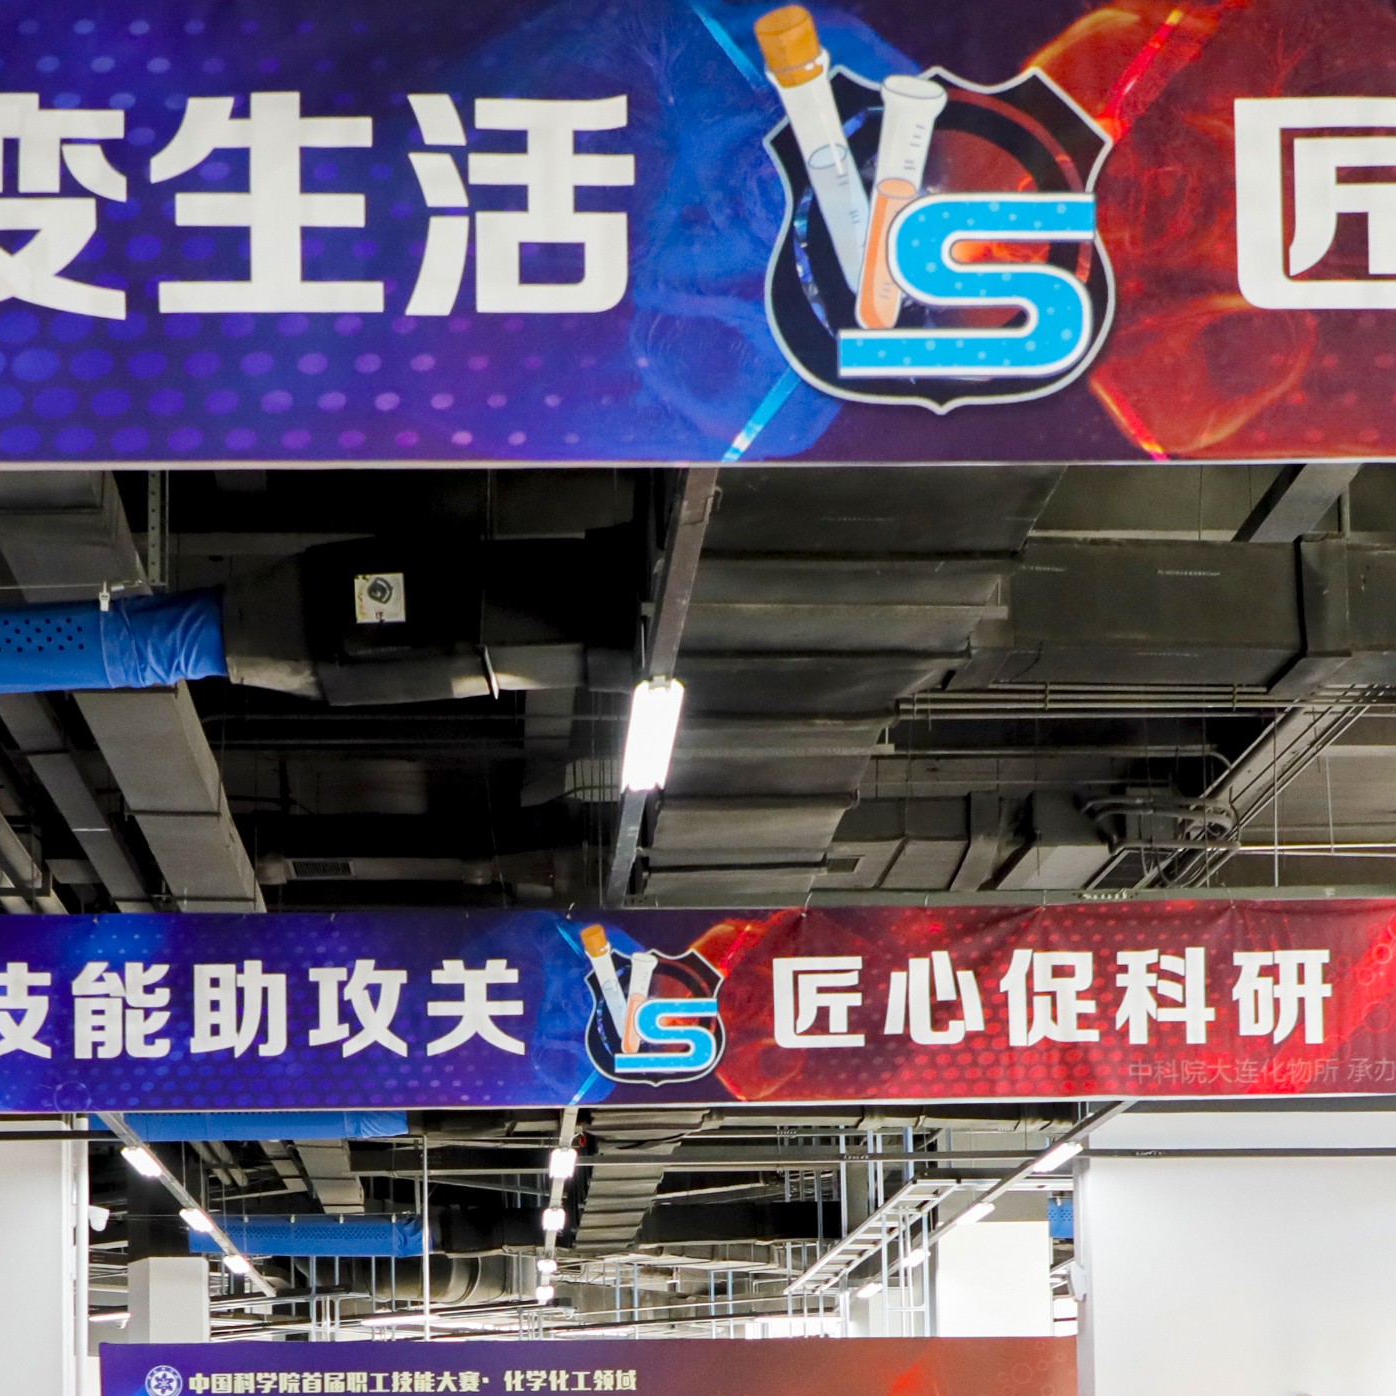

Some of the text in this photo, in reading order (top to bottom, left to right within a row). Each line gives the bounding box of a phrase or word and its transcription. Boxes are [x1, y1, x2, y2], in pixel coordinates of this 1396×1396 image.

[772, 947, 1334, 1050] 匠心促科研
[1128, 1057, 1340, 1088] 中科院大连化物所
[503, 1369, 638, 1392] 化学化工领域
